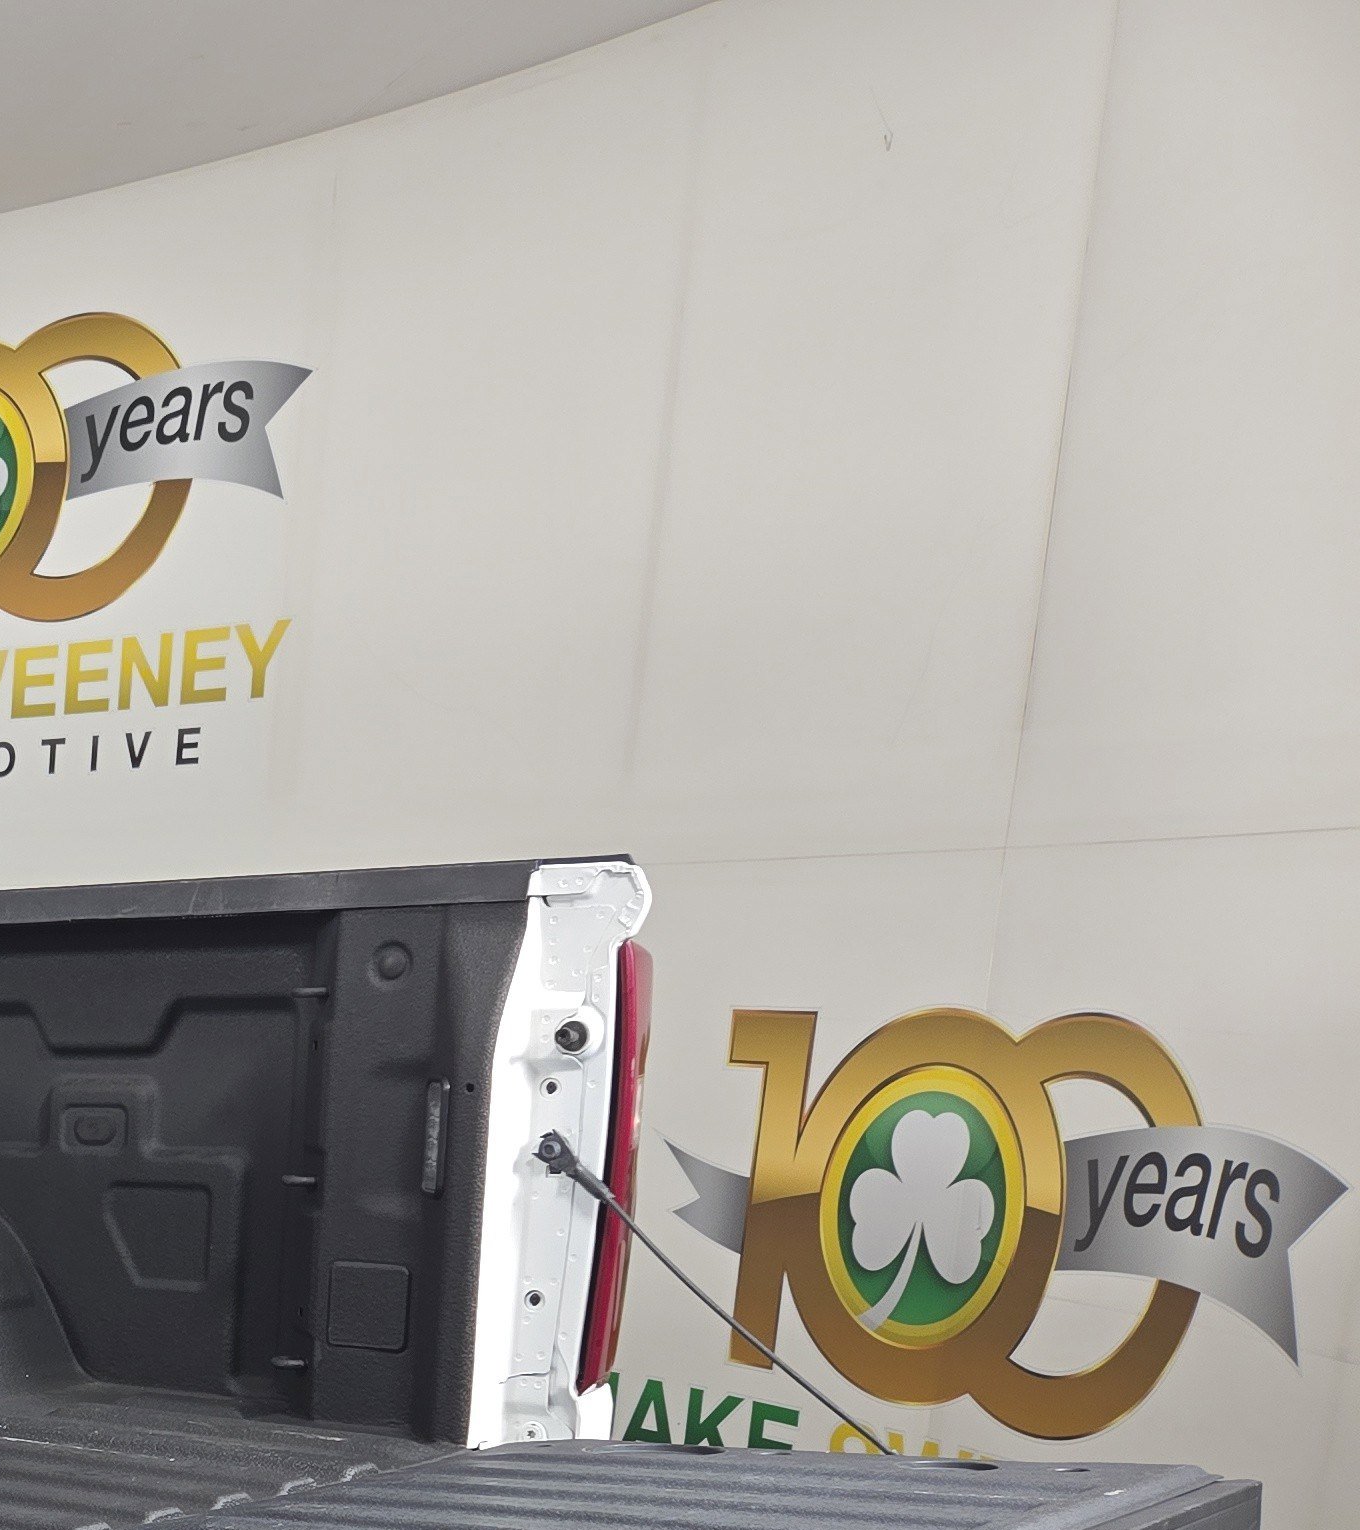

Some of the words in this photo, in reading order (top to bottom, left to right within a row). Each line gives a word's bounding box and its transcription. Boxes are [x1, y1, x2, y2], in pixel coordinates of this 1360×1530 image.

[79, 379, 255, 482] years
[727, 1006, 1203, 1440] 100
[1073, 1150, 1281, 1260] years
